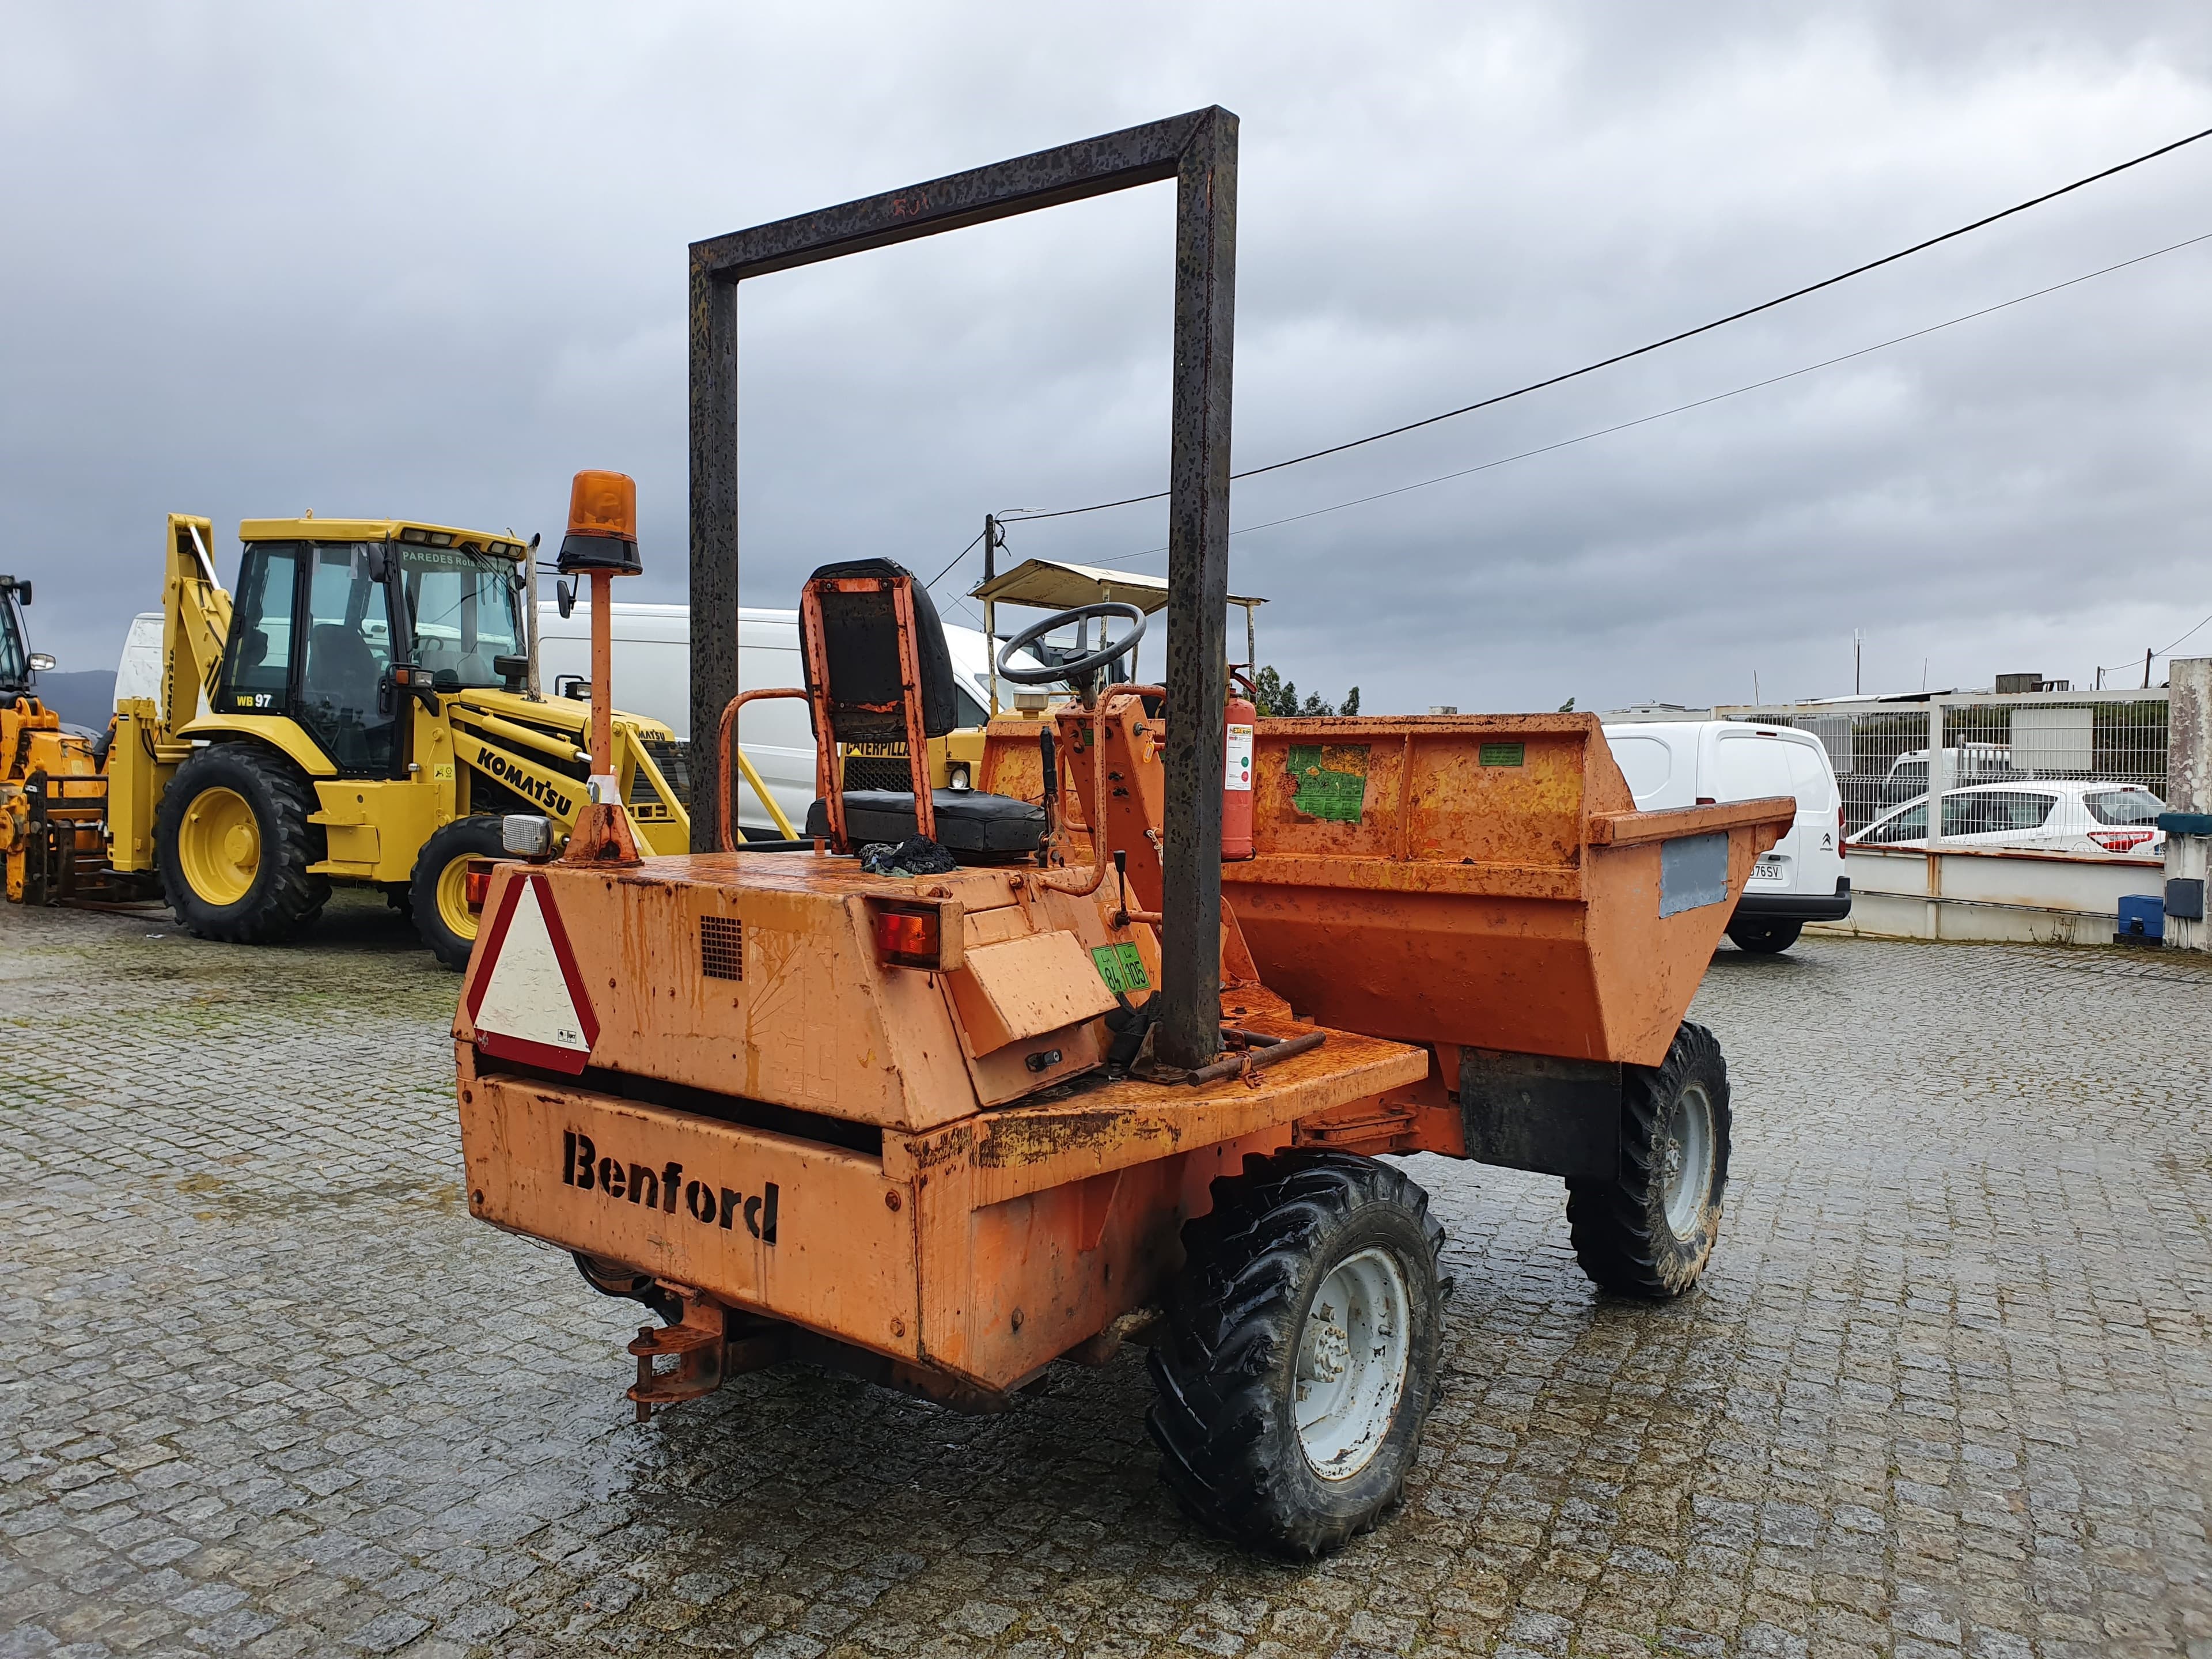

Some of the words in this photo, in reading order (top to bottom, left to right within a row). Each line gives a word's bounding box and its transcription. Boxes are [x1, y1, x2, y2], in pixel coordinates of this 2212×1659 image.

[403, 551, 453, 565] PAREDES
[164, 649, 174, 734] KOMATSU
[237, 695, 253, 707] WB
[255, 694, 271, 708] 97
[638, 729, 665, 741] MATSU
[846, 742, 908, 756] CATERPILLA
[477, 747, 573, 816] KOMATSU
[1104, 966, 1122, 991] 84
[1124, 960, 1146, 986] 105
[562, 1129, 779, 1246] Benford
